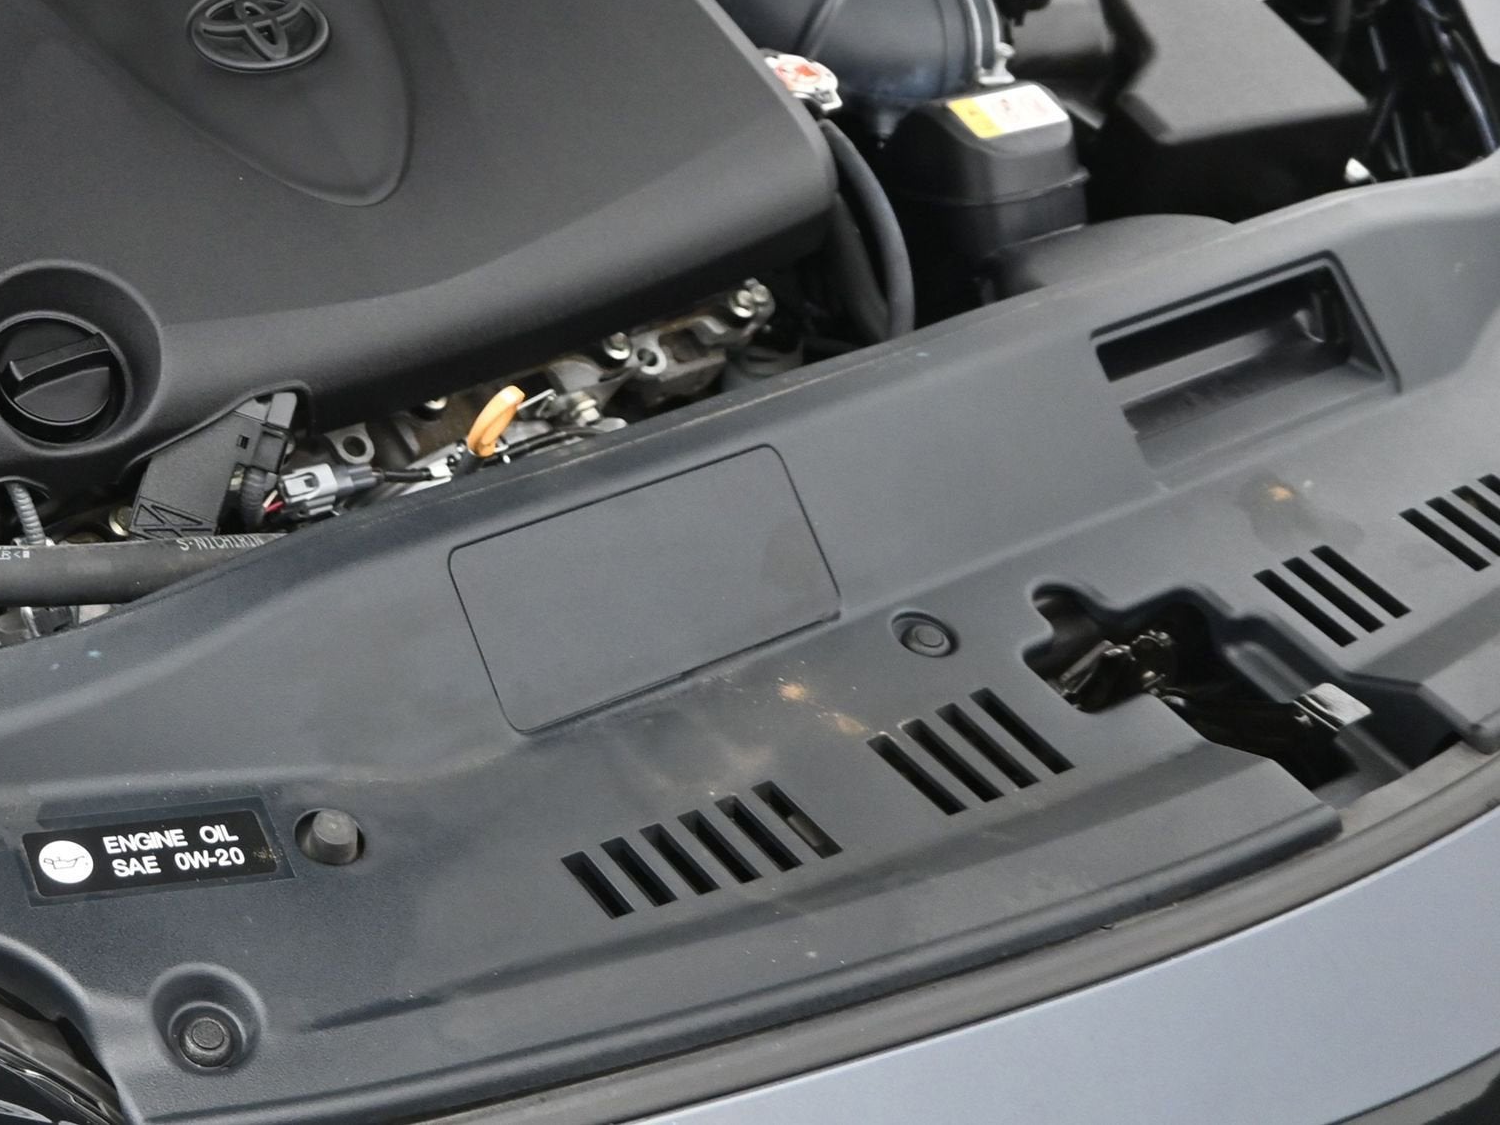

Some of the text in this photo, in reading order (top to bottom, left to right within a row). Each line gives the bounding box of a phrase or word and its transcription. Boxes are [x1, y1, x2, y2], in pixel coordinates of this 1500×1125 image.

[102, 824, 239, 855] ENGINE OIL
[111, 846, 245, 878] SAE 0W-20
